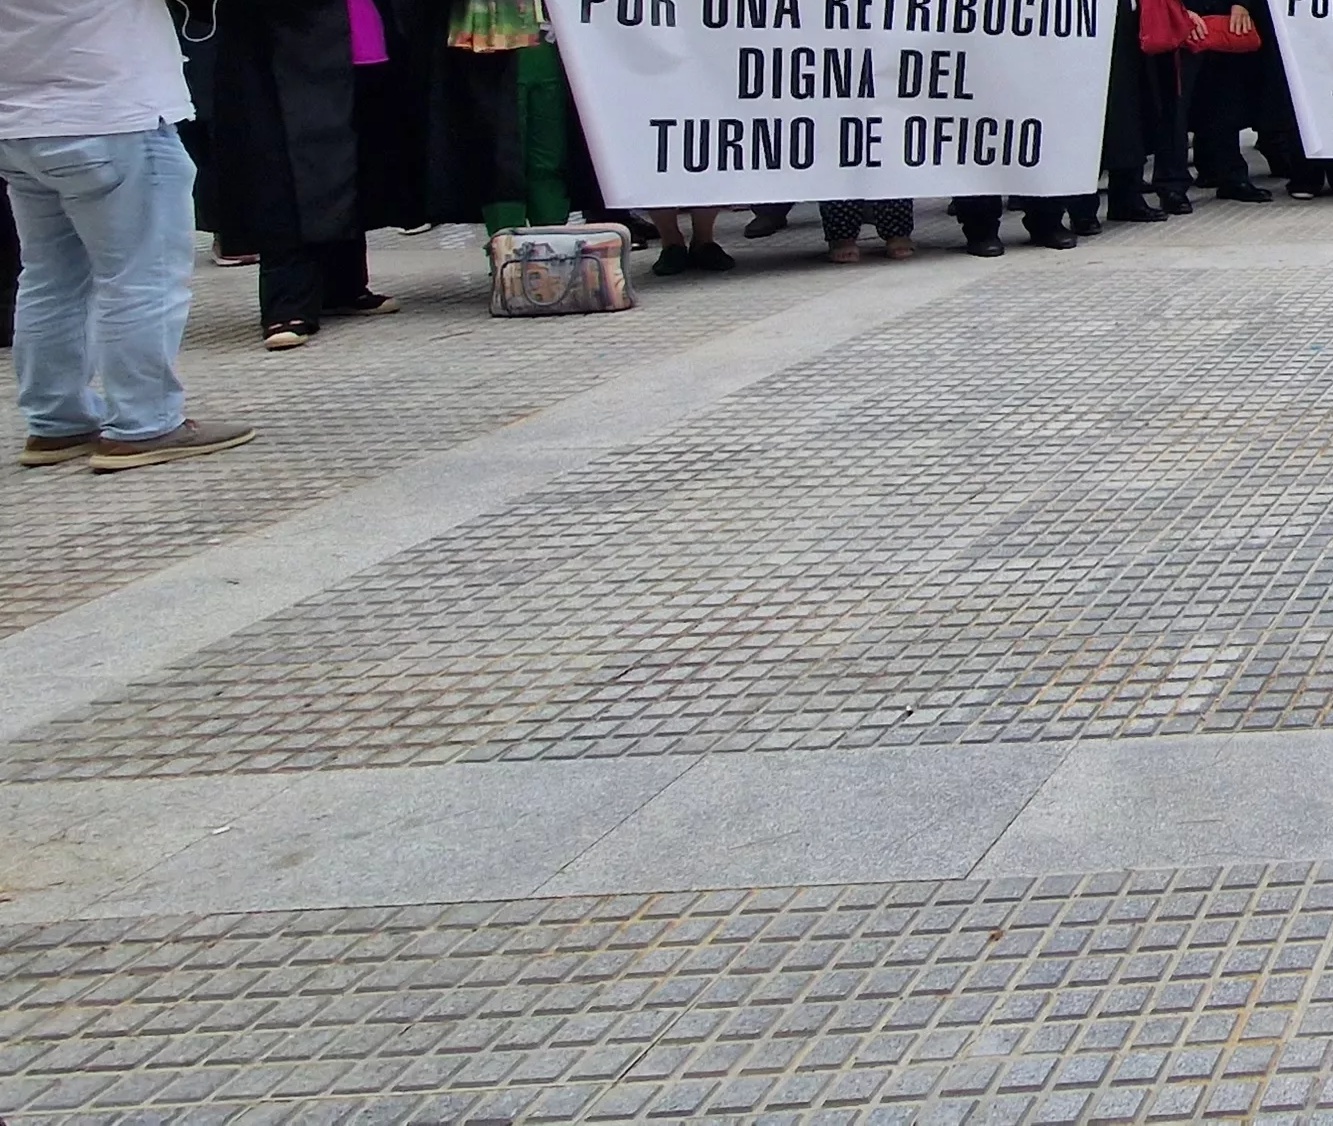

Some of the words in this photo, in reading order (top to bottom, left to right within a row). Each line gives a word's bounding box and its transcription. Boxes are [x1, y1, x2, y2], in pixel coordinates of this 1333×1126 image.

[738, 47, 875, 99] DIGNA
[898, 50, 973, 100] DEL
[650, 117, 814, 172] TURNO
[839, 117, 882, 167] DE
[904, 116, 1041, 167] OFICIO
